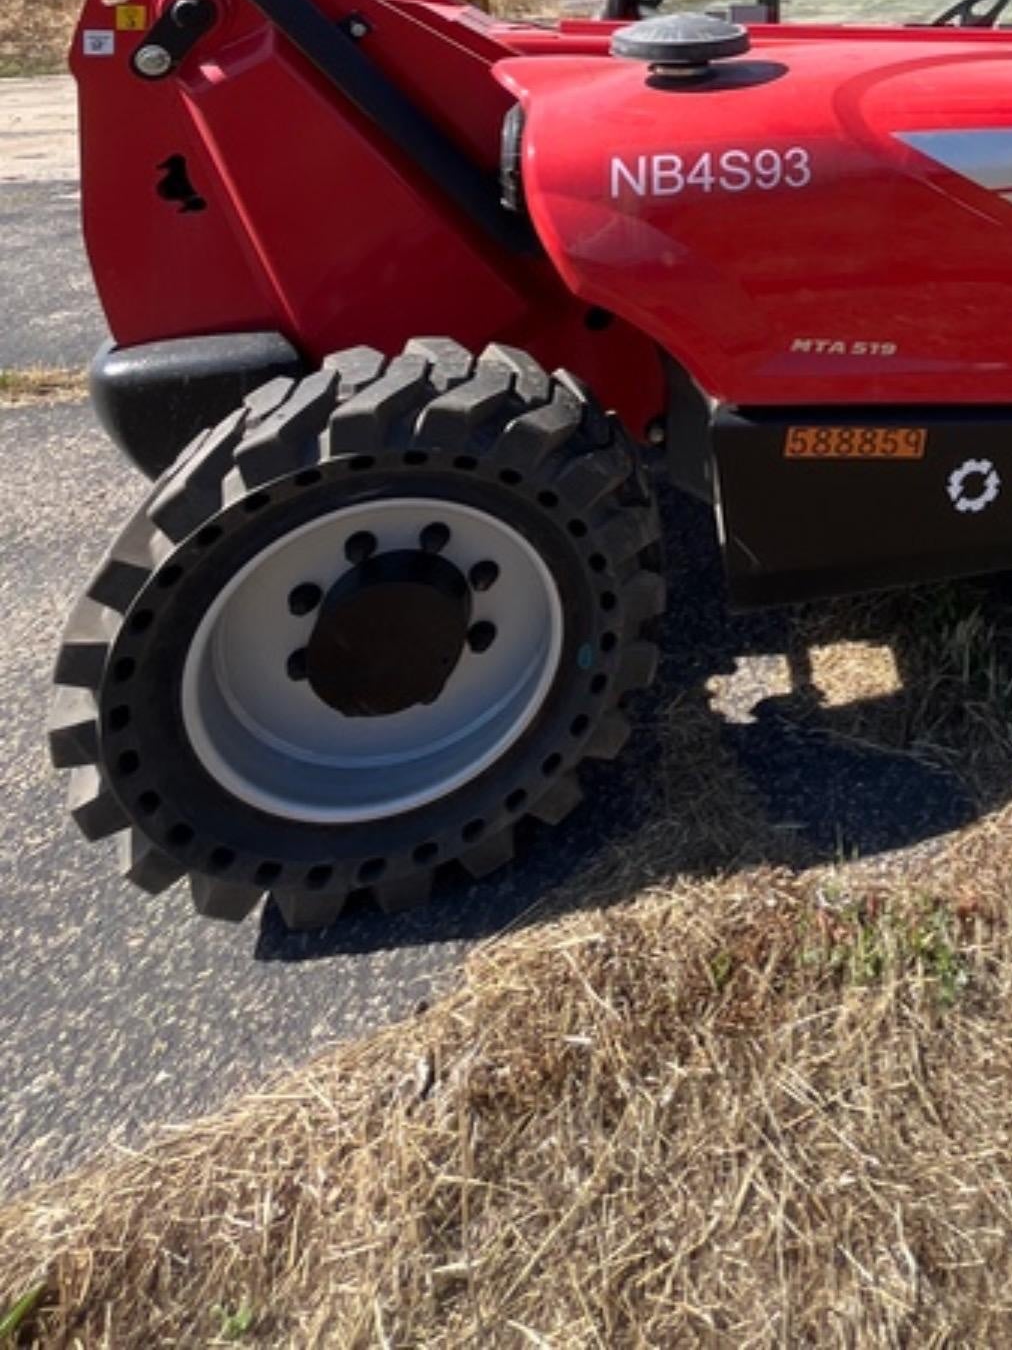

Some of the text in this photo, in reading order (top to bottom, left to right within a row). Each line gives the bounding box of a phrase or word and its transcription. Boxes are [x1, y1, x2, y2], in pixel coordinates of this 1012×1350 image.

[610, 147, 811, 198] NB4S93
[790, 338, 898, 355] MTA 519
[788, 428, 923, 454] 588859
